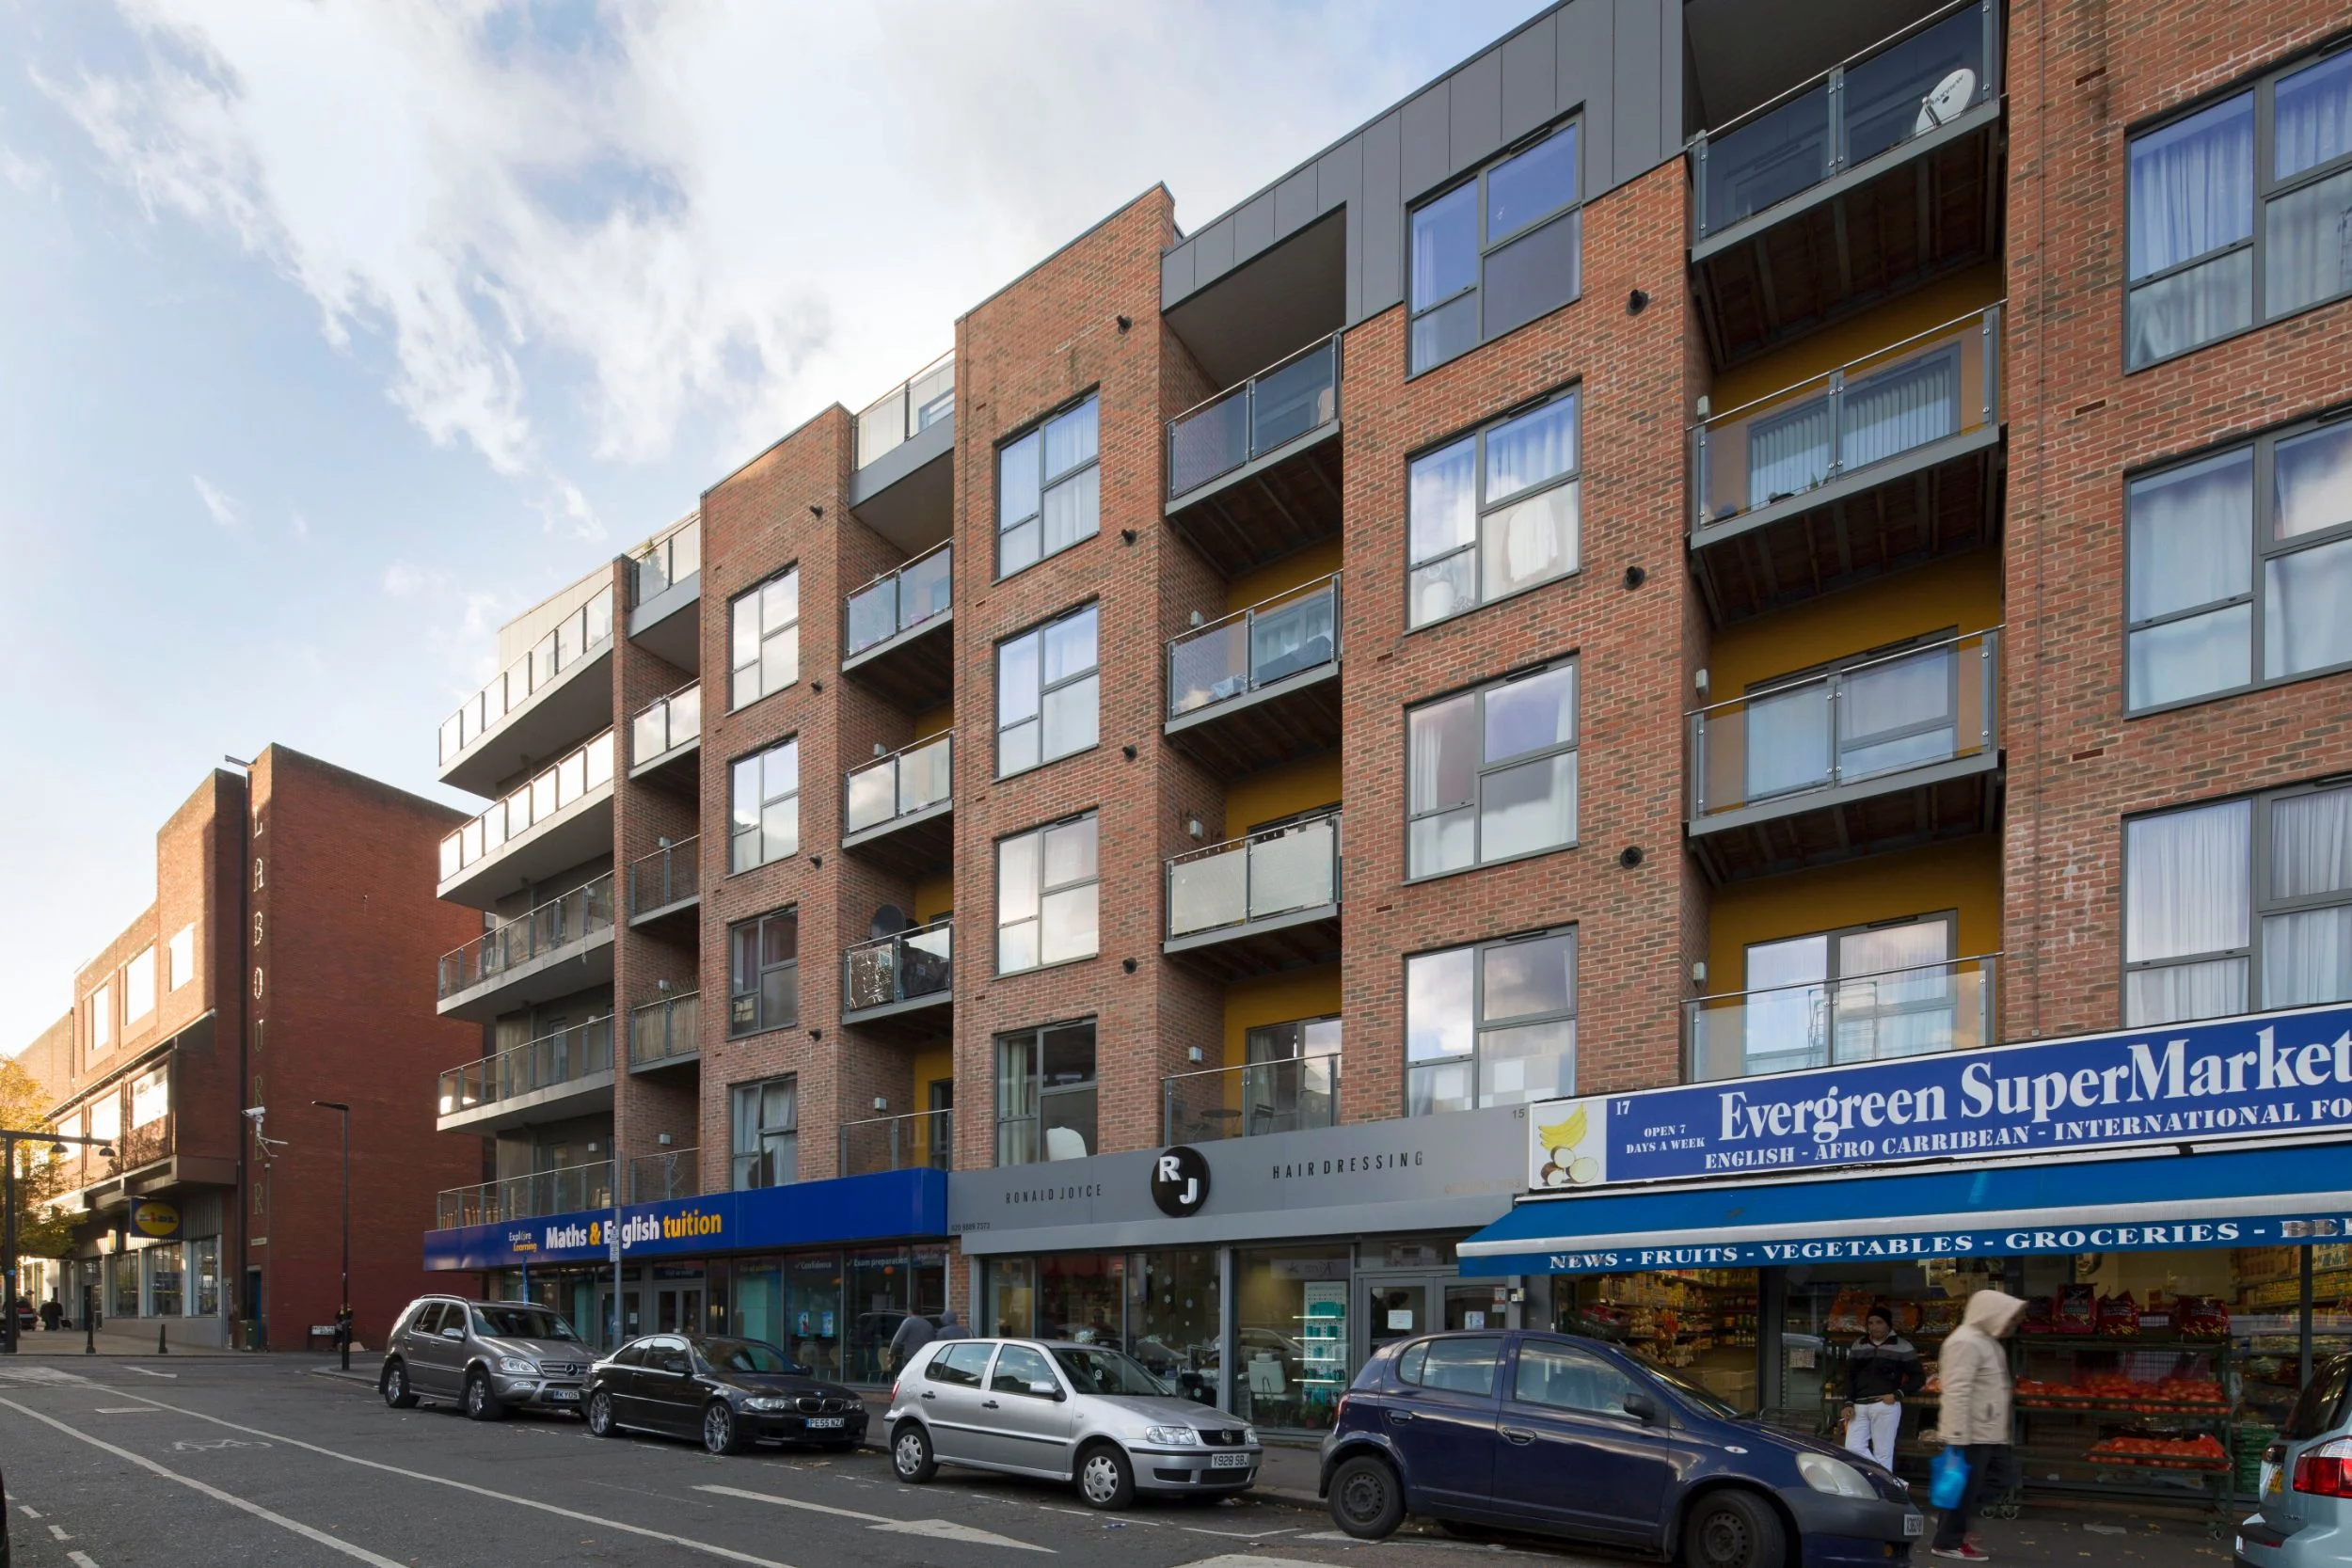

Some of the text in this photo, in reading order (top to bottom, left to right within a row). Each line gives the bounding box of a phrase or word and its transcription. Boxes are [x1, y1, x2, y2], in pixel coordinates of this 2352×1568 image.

[1718, 1025, 2352, 1143] Evergreen SuperMarket
[1512, 1108, 1525, 1119] 15
[1615, 1100, 1630, 1116] 17
[1644, 1124, 1687, 1138] OPEN 7
[1705, 1147, 1794, 1169] ENGLISH
[1814, 1139, 1875, 1161] AFRO
[1882, 1125, 2030, 1155] CARRIBEAN
[2054, 1101, 2301, 1141] INTERNATIONAL
[2311, 1098, 2352, 1120] FO
[1626, 1137, 1705, 1154] DAYS A WEEK
[1159, 1155, 1182, 1182] R
[1272, 1150, 1423, 1180] HAIRDRESSING
[1006, 1183, 1102, 1204] RONALD JOYCE
[1179, 1178, 1198, 1204] J
[509, 1230, 532, 1243] Explore
[546, 1224, 587, 1249] Maths
[589, 1222, 601, 1246] &
[604, 1214, 660, 1249] Eglish
[663, 1209, 722, 1239] tuition
[513, 1242, 537, 1253] Learning
[1549, 1253, 1618, 1269] NEWS
[1640, 1246, 1739, 1265] FRUITS
[1762, 1235, 1974, 1259] VEGETABLES
[2006, 1223, 2240, 1250] GROCERIES
[853, 1258, 870, 1267] Exam
[1214, 1455, 1233, 1466] Y928
